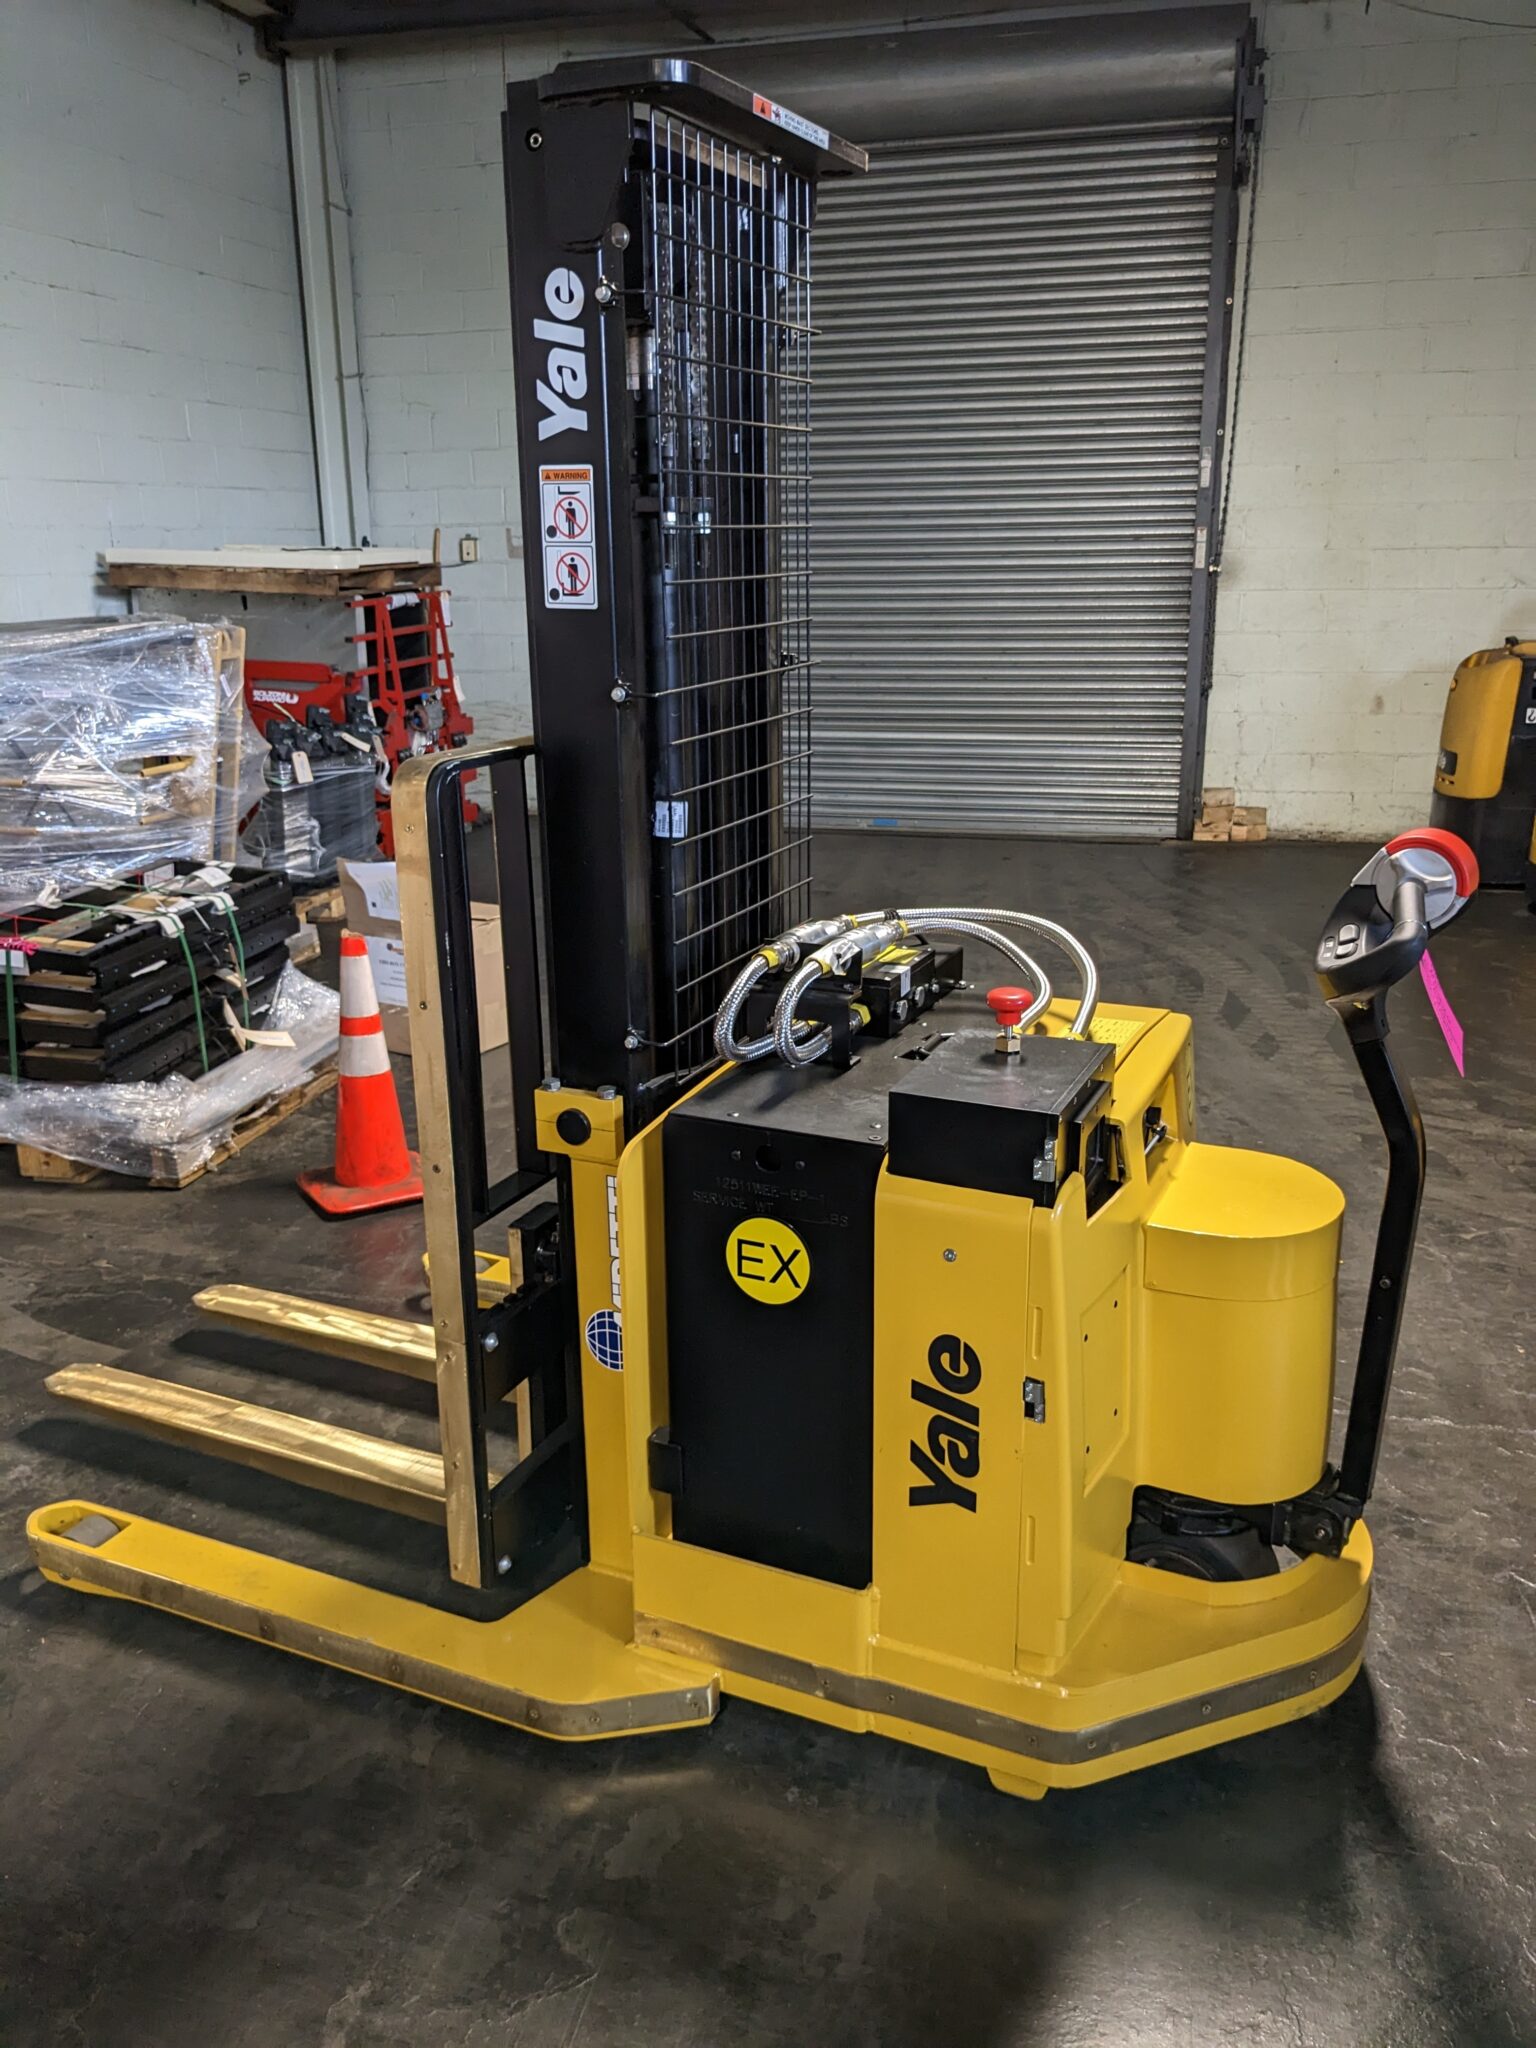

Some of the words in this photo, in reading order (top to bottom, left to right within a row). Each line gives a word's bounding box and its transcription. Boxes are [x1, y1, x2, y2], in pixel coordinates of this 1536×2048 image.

[533, 267, 588, 441] Yale
[553, 471, 588, 480] WARNING
[692, 1190, 747, 1211] SERVICE
[737, 1238, 802, 1289] EX
[909, 1334, 981, 1513] Yale
